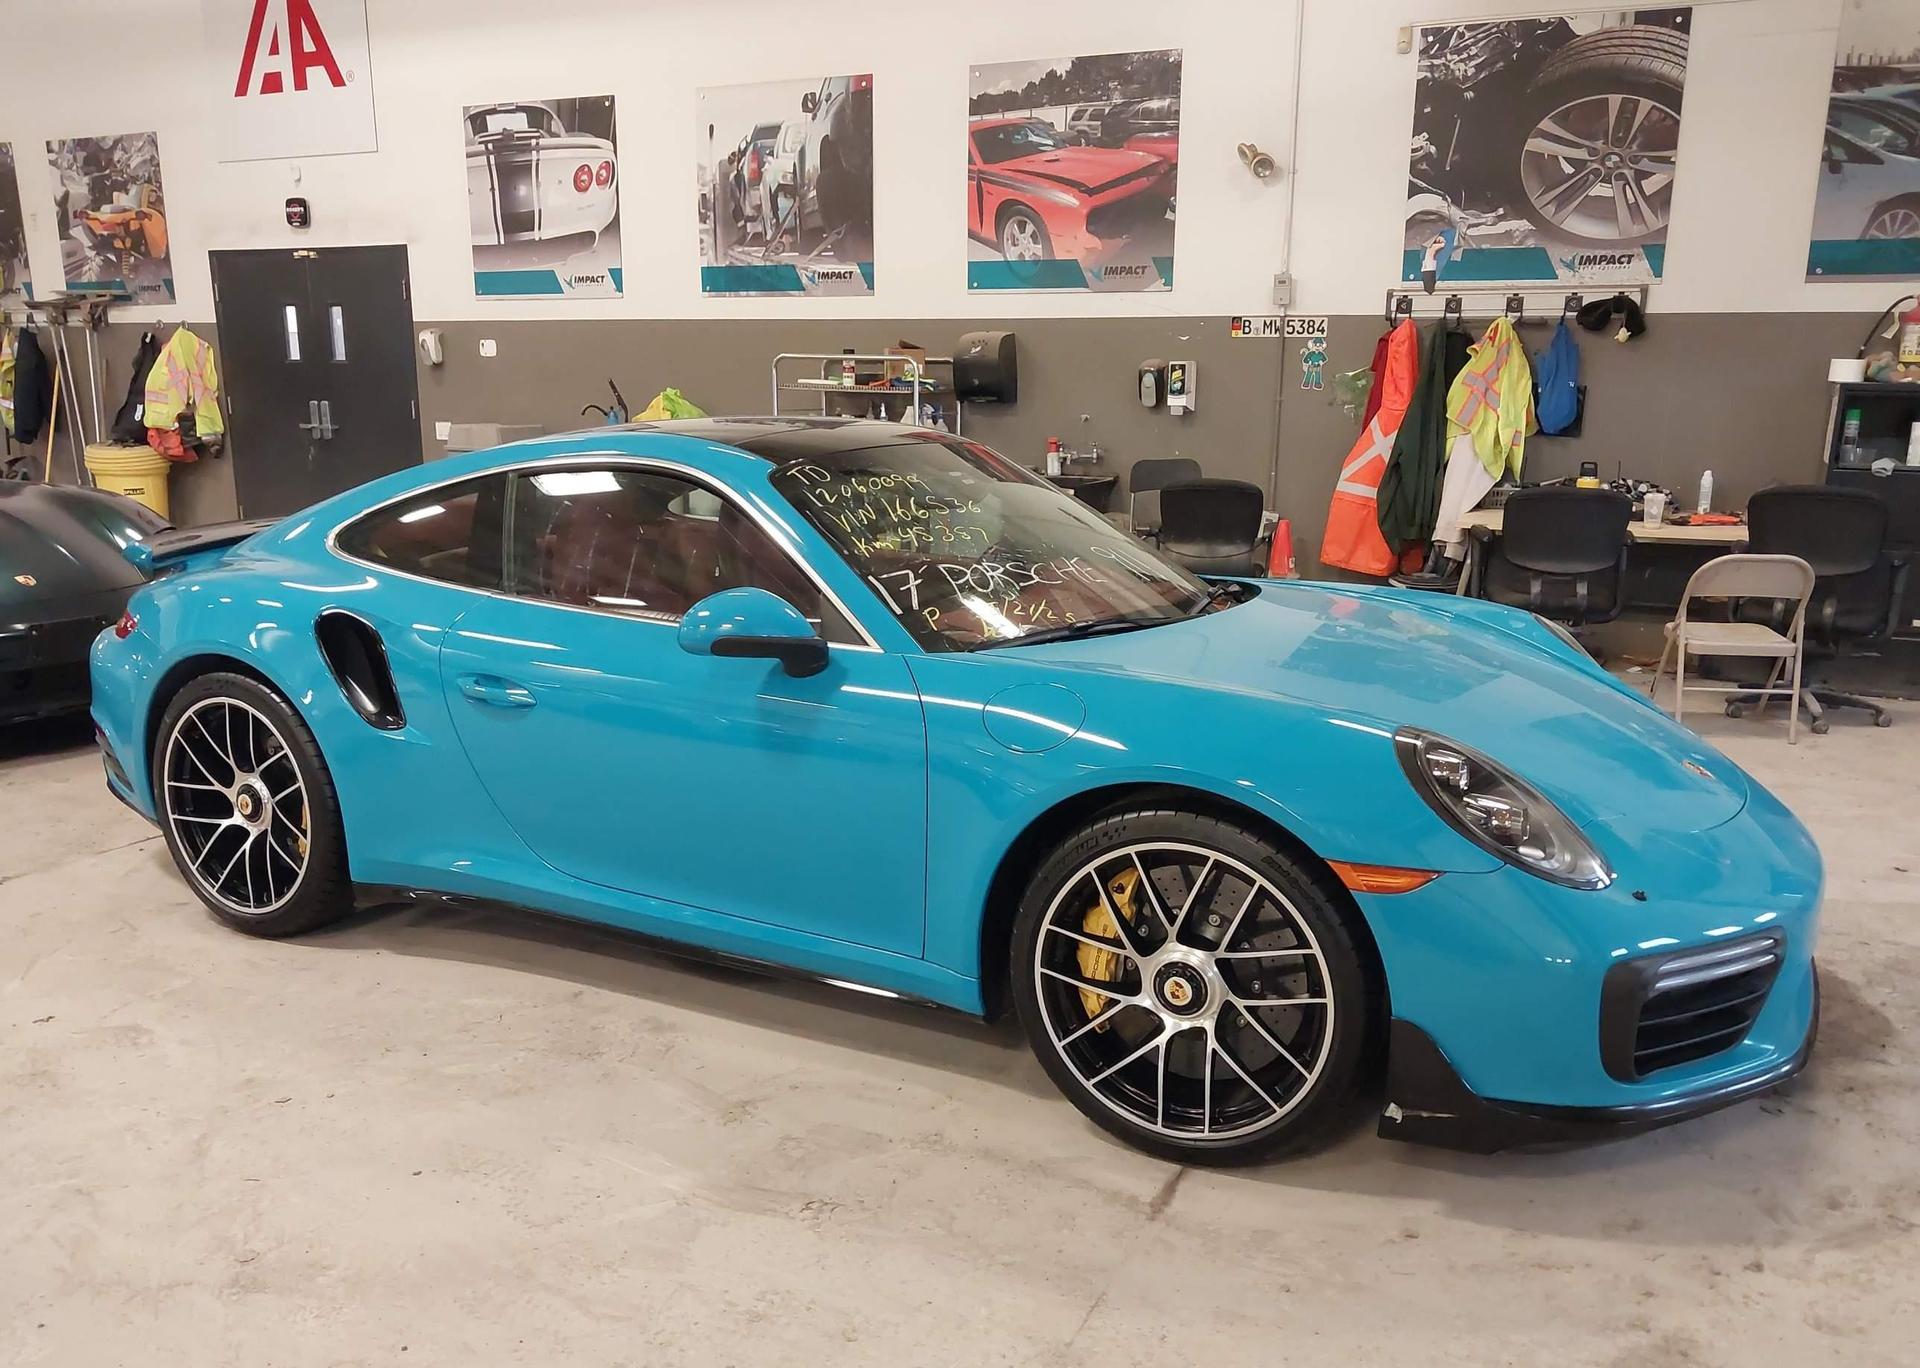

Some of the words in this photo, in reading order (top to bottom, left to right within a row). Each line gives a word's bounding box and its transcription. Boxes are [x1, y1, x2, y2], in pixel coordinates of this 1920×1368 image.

[1578, 253, 1635, 265] IMPACT
[574, 275, 605, 284] IMPACT
[817, 270, 854, 280] IMPACT
[1103, 265, 1148, 276] IMPACT
[1242, 319, 1252, 335] B
[1286, 319, 1326, 335] 5384
[786, 465, 831, 485] TD
[802, 473, 933, 507] 12060099
[823, 502, 876, 533] VIN
[880, 495, 981, 522] 166536
[937, 556, 1108, 600] PORSCHE
[1090, 923, 1109, 980] PORSHE
